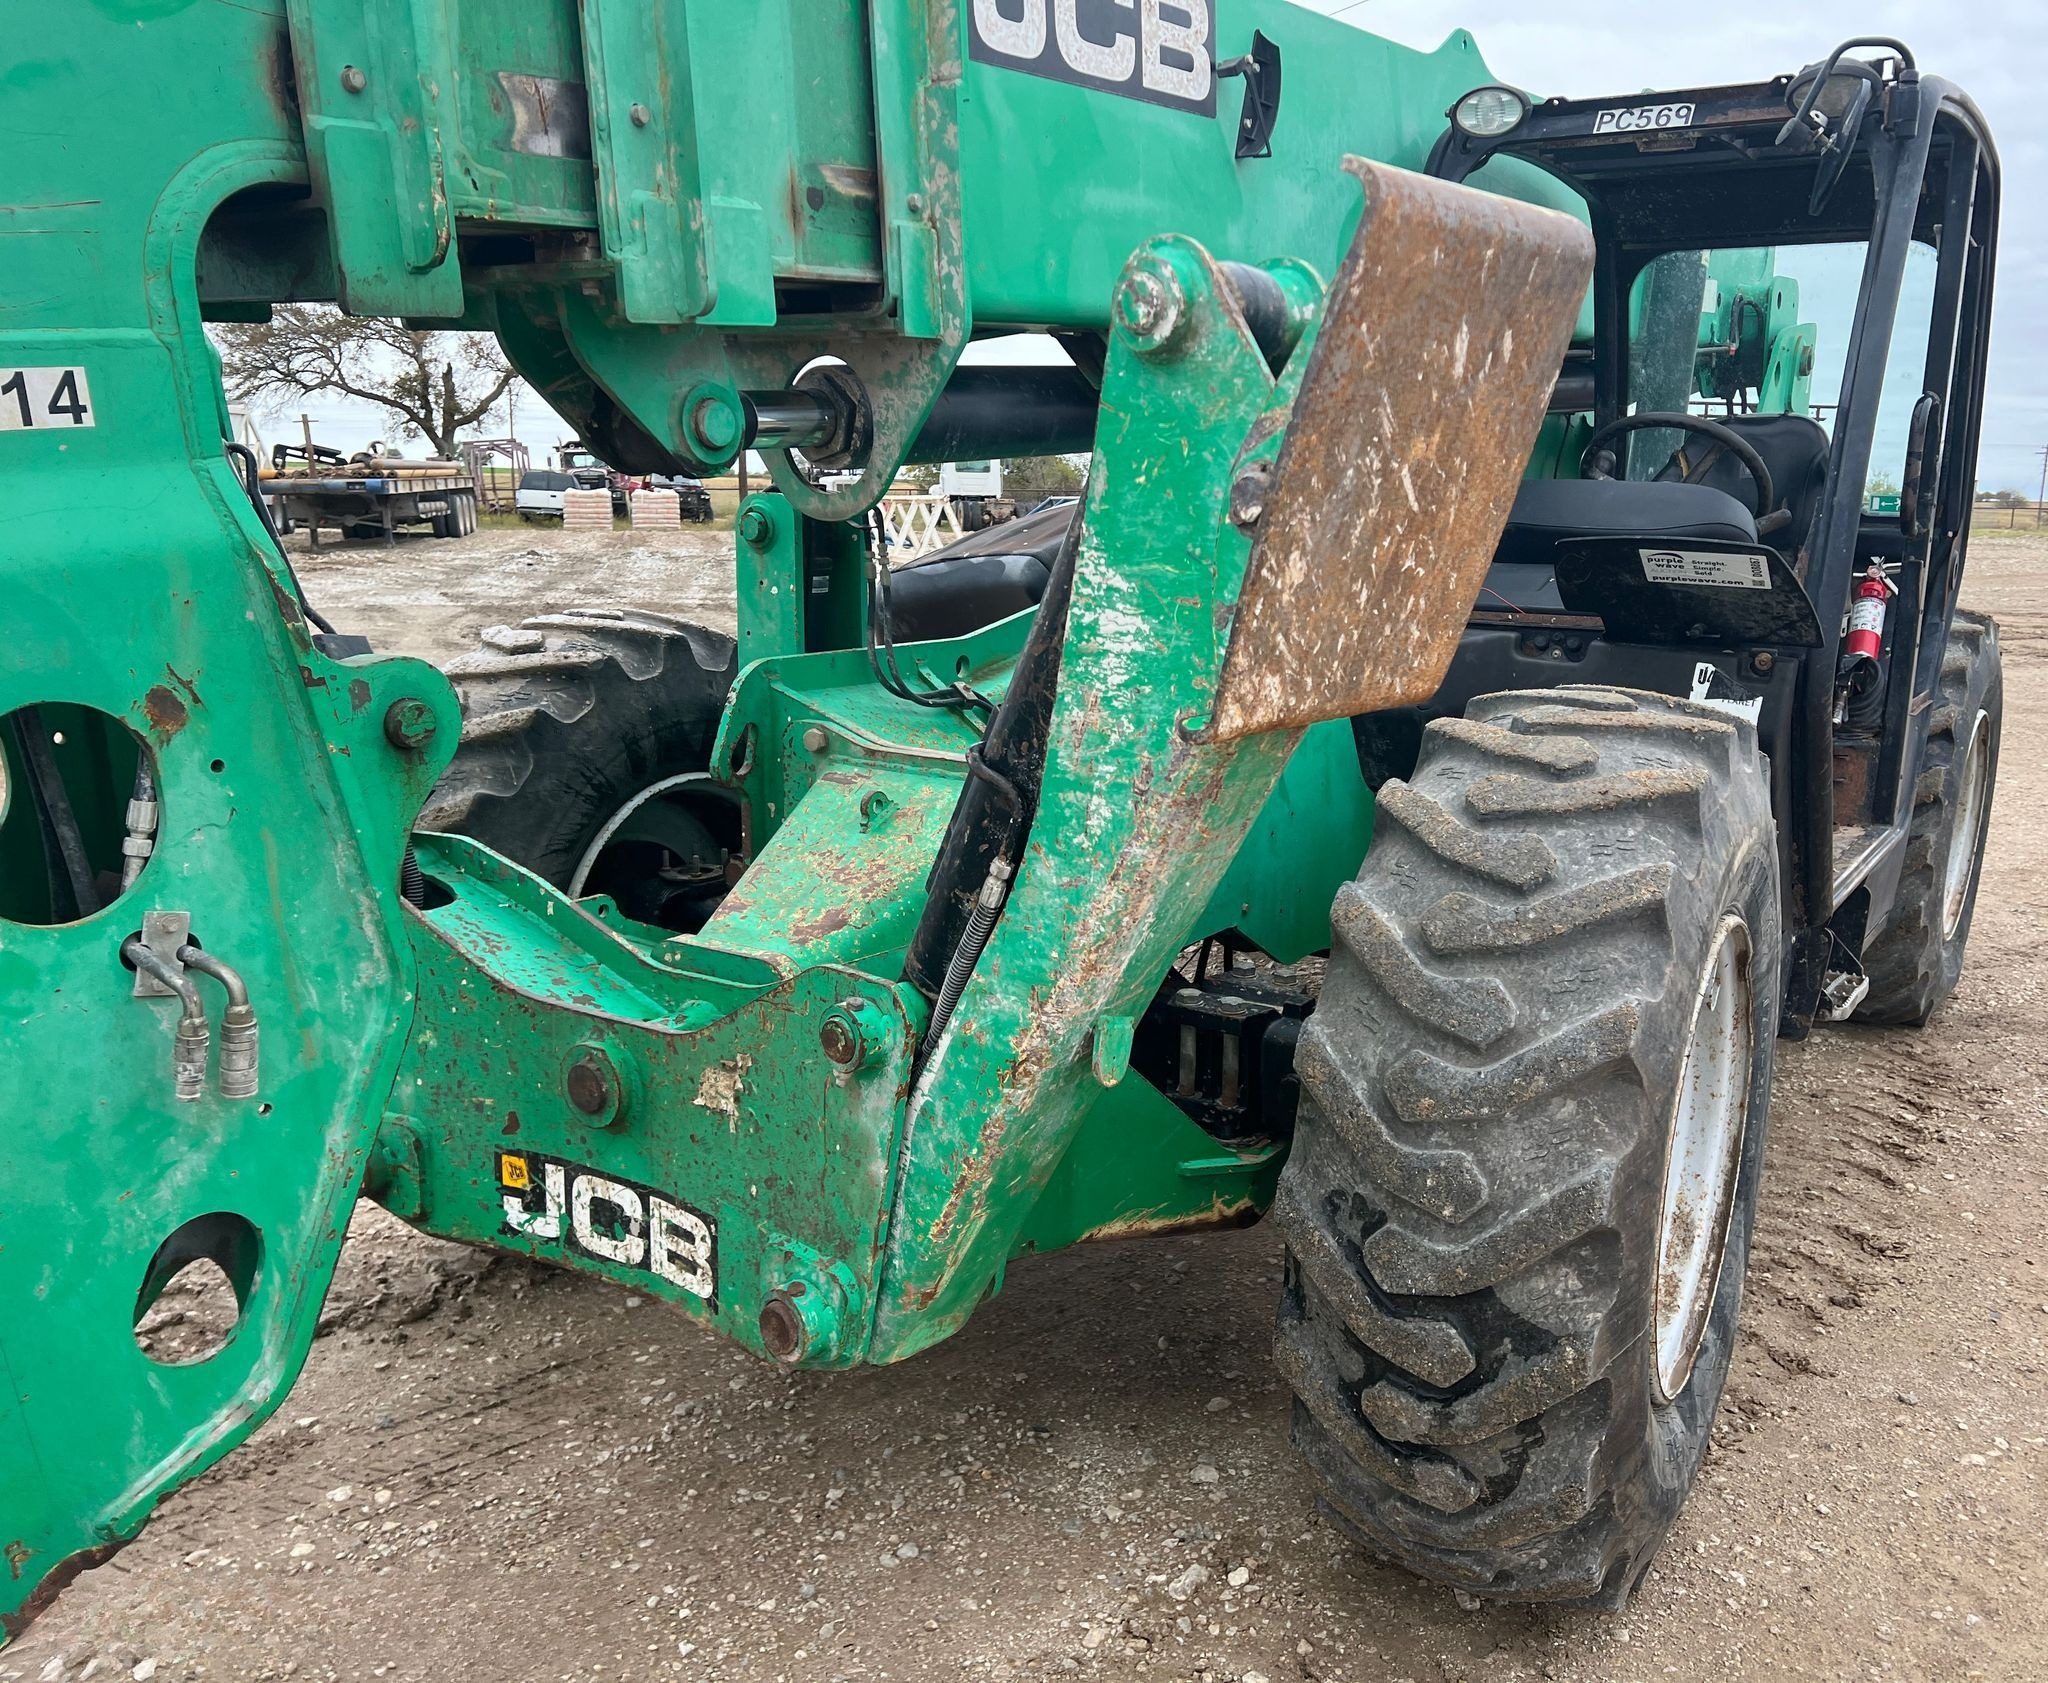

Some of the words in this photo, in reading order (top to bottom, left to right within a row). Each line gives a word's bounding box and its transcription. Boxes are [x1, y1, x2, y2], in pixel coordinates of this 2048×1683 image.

[1596, 104, 1693, 132] PC569
[0, 370, 88, 427] 14
[1652, 575, 1744, 586] purplewave.com
[503, 1162, 713, 1299] JCB
